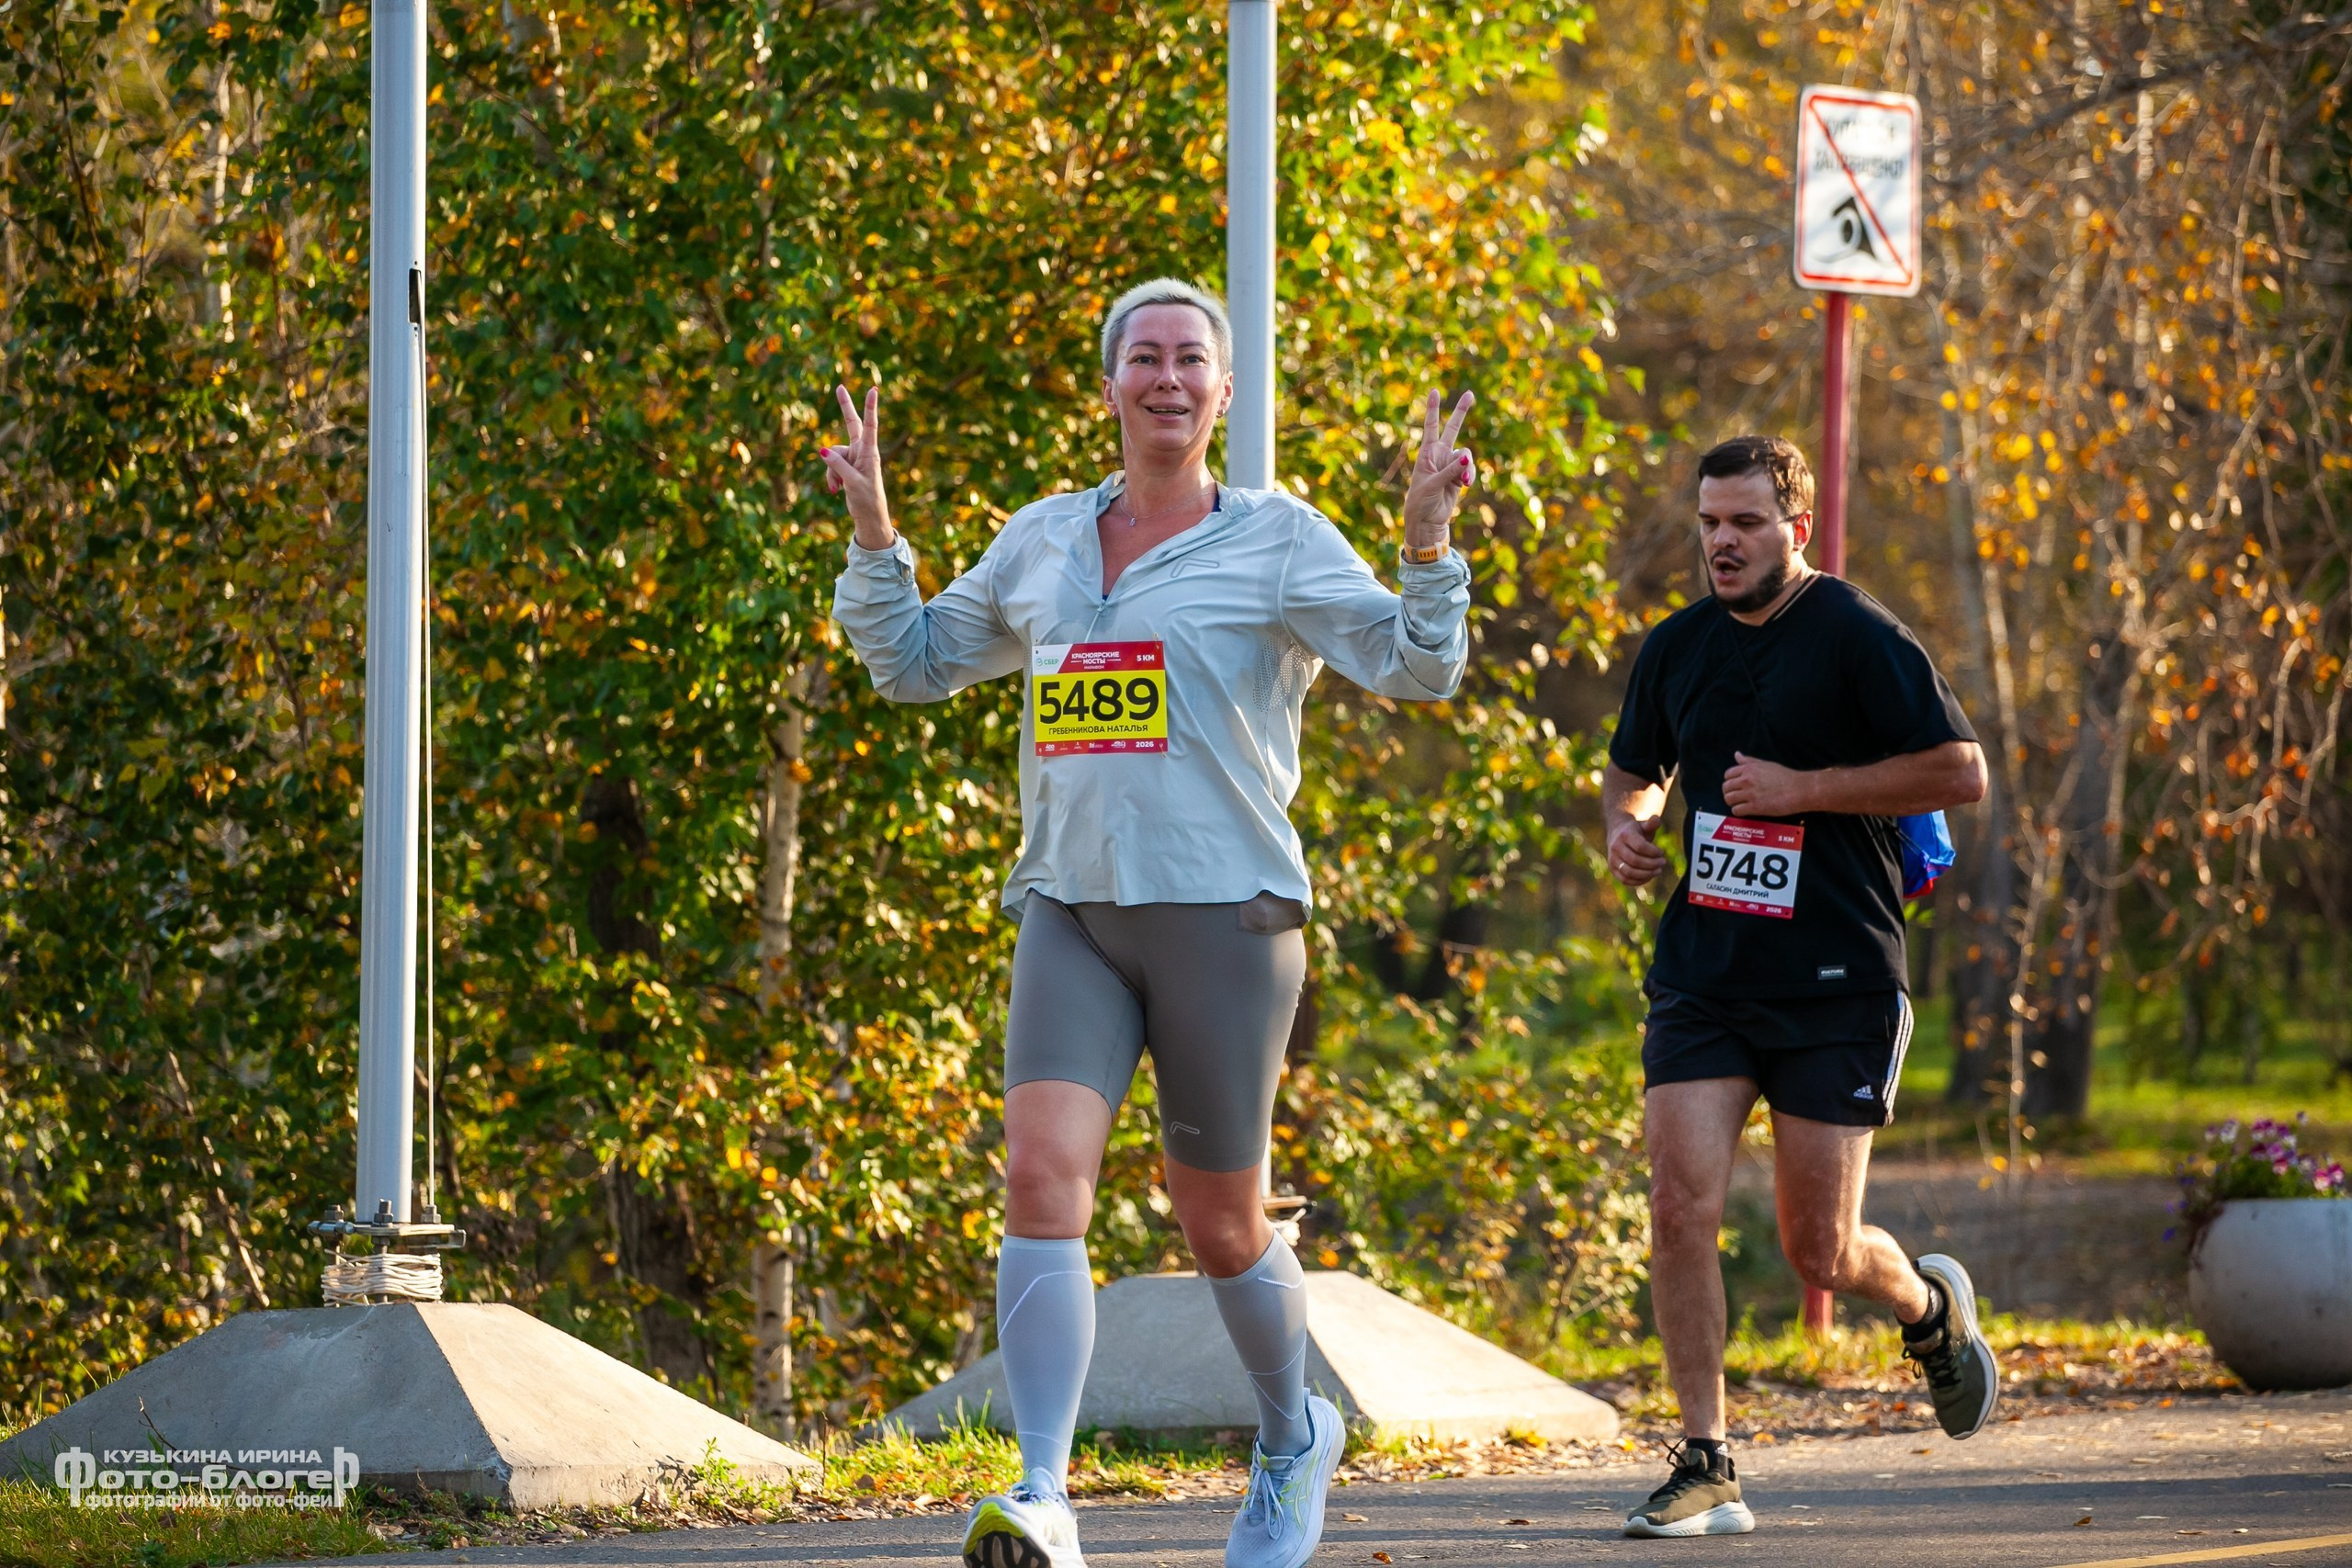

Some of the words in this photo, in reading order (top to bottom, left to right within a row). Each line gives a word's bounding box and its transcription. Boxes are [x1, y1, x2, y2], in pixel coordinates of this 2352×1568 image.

[1039, 677, 1159, 725] 5489
[1048, 726, 1105, 735] ГРЕБЕННИКОВА
[1107, 724, 1148, 733] НАТАЛЬЯ
[1696, 842, 1790, 891] 5748
[1733, 887, 1770, 899] ДМИТРИЙ
